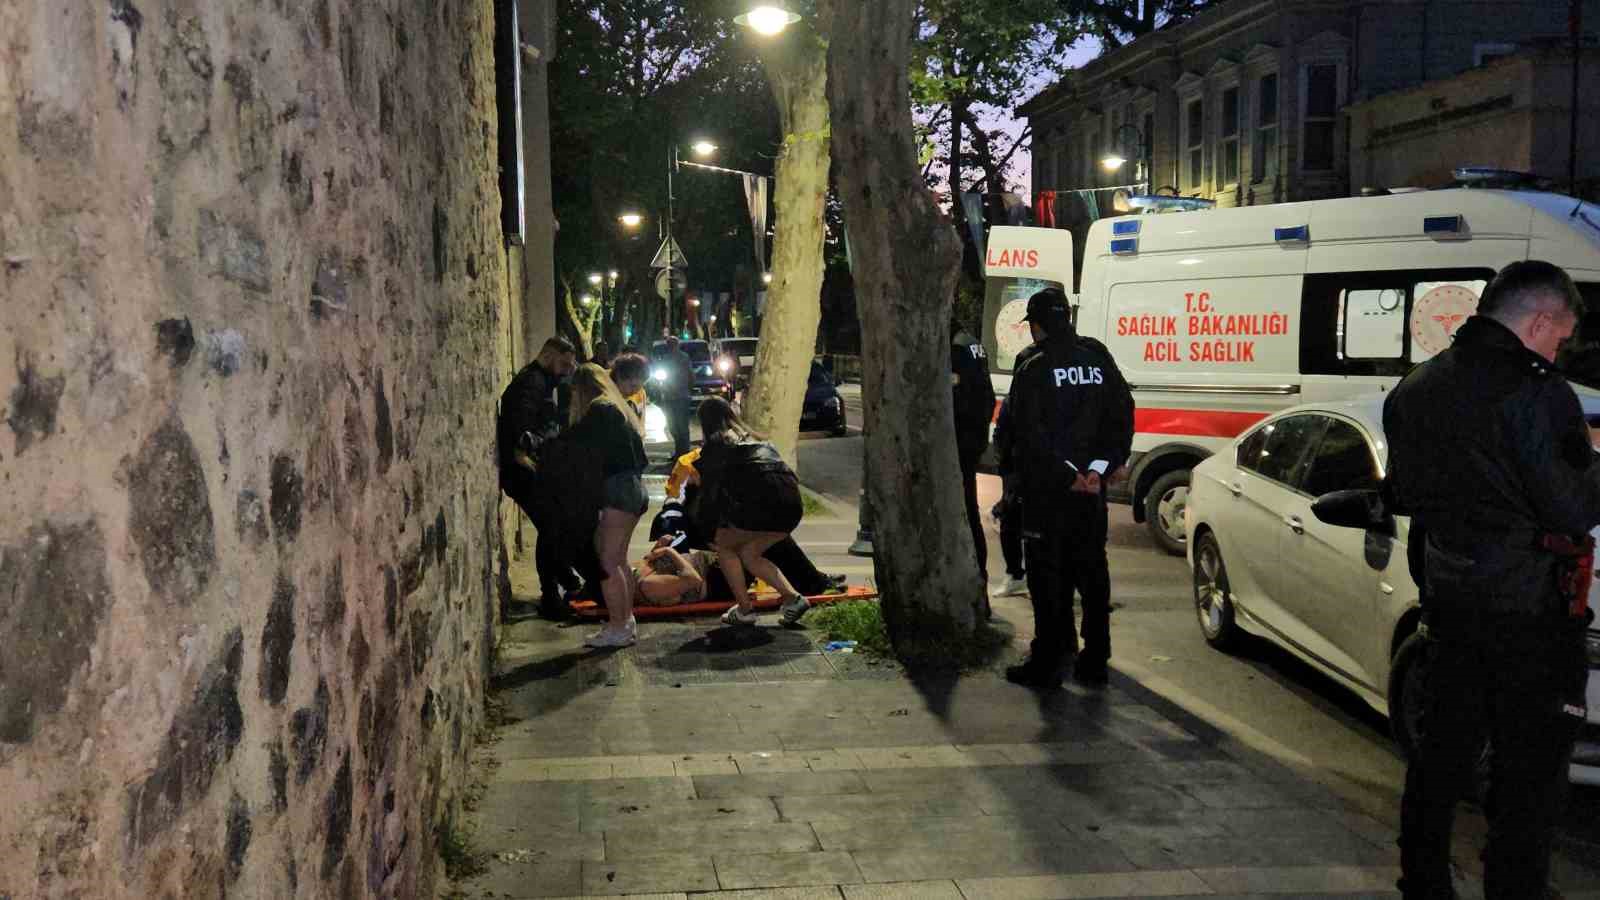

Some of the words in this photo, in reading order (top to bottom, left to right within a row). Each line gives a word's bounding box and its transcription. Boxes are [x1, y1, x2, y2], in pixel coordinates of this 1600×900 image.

[987, 248, 1039, 268] LANS
[1184, 292, 1216, 313] T.C.
[1117, 313, 1177, 336] SAĞLIK
[1188, 312, 1288, 335] BAKANLIĞI
[1143, 338, 1181, 362] ACİL
[1189, 338, 1255, 362] SAĞLIK
